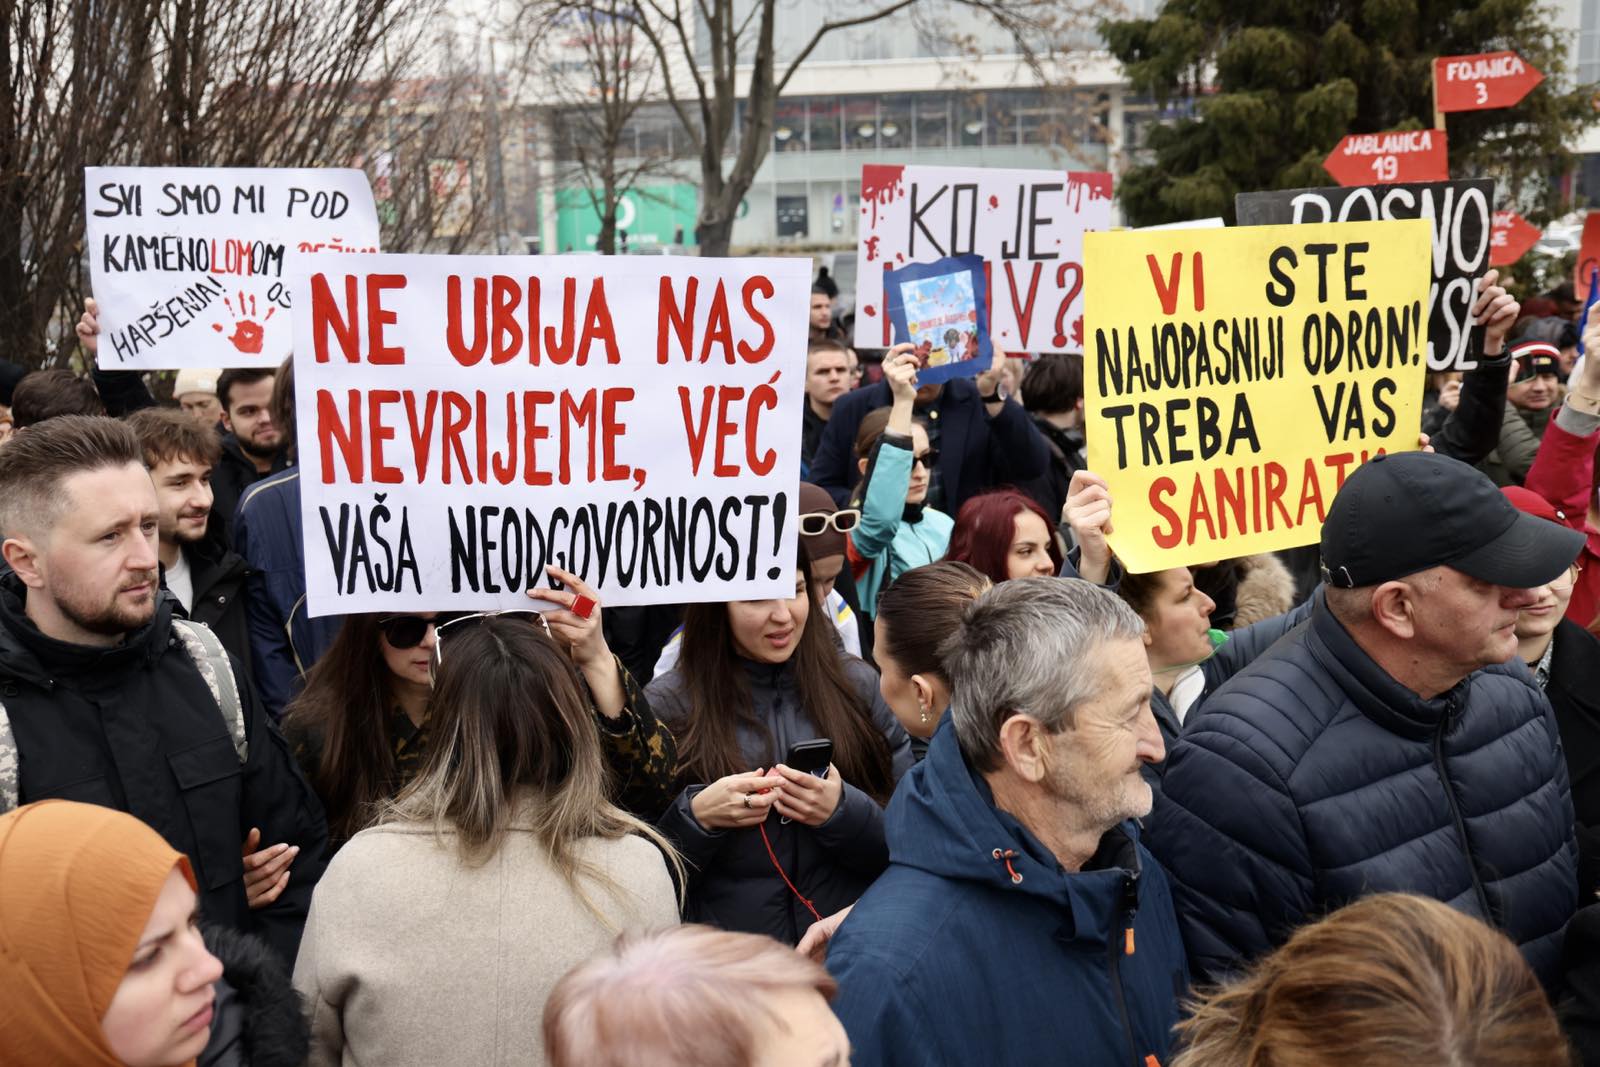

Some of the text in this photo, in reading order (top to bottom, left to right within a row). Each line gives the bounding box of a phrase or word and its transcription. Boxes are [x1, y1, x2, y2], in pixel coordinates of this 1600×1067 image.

[1446, 56, 1525, 81] FOJNICA
[1474, 82, 1488, 104] 3
[1343, 131, 1432, 156] JABLANICA
[1371, 155, 1398, 181] 19
[93, 183, 349, 219] SVI SMO MI POD
[909, 183, 1064, 260] KO JE
[104, 234, 285, 277] KAMENOLOMOM
[1146, 241, 1369, 315] VI STE
[110, 275, 227, 362] HAPŠENJA!
[311, 273, 775, 366] NE UBIJA NAS
[1096, 300, 1421, 397] NAJOPASNIJI ODRON!
[316, 370, 782, 491] NEVRIJEME, VEĆ
[1101, 376, 1397, 470] TREBA VAS
[319, 492, 787, 595] VAŠA NEODGOVORNOST!
